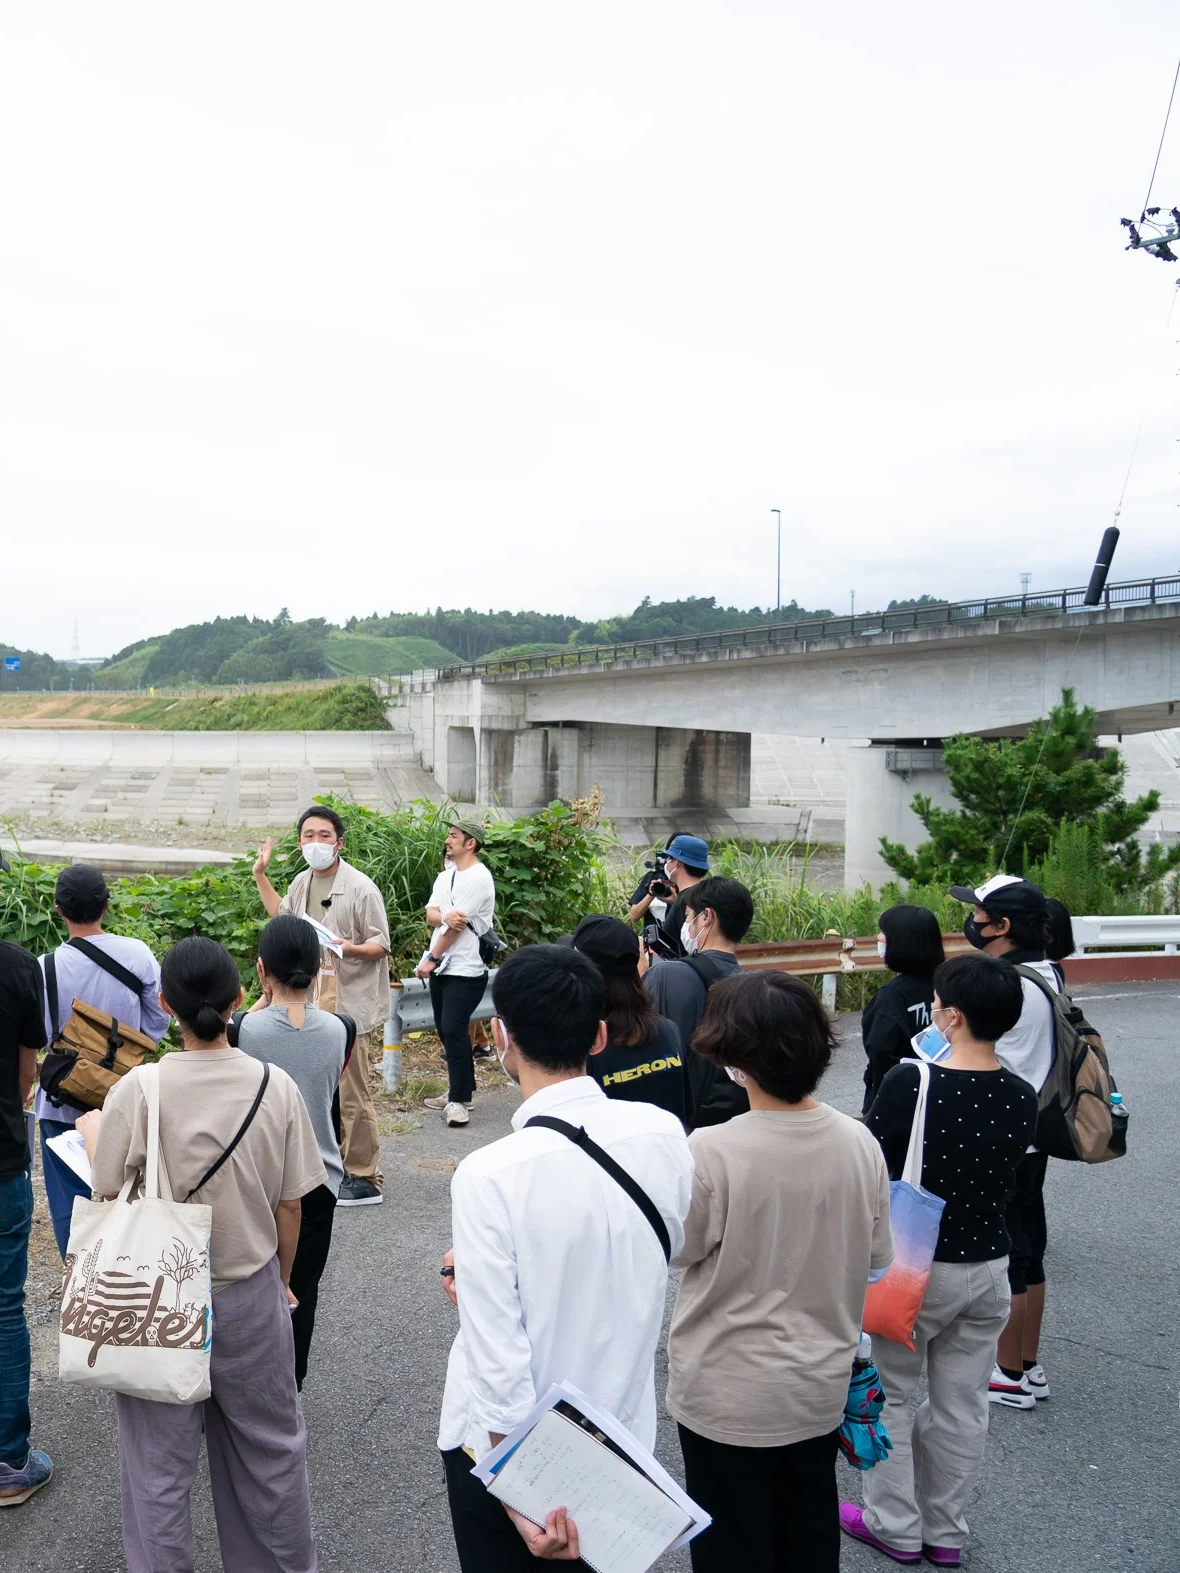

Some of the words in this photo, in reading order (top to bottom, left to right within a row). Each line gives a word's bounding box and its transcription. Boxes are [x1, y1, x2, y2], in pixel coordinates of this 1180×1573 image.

[907, 1002, 934, 1026] Th
[603, 1053, 682, 1087] HERON
[61, 1262, 208, 1368] ngeles
